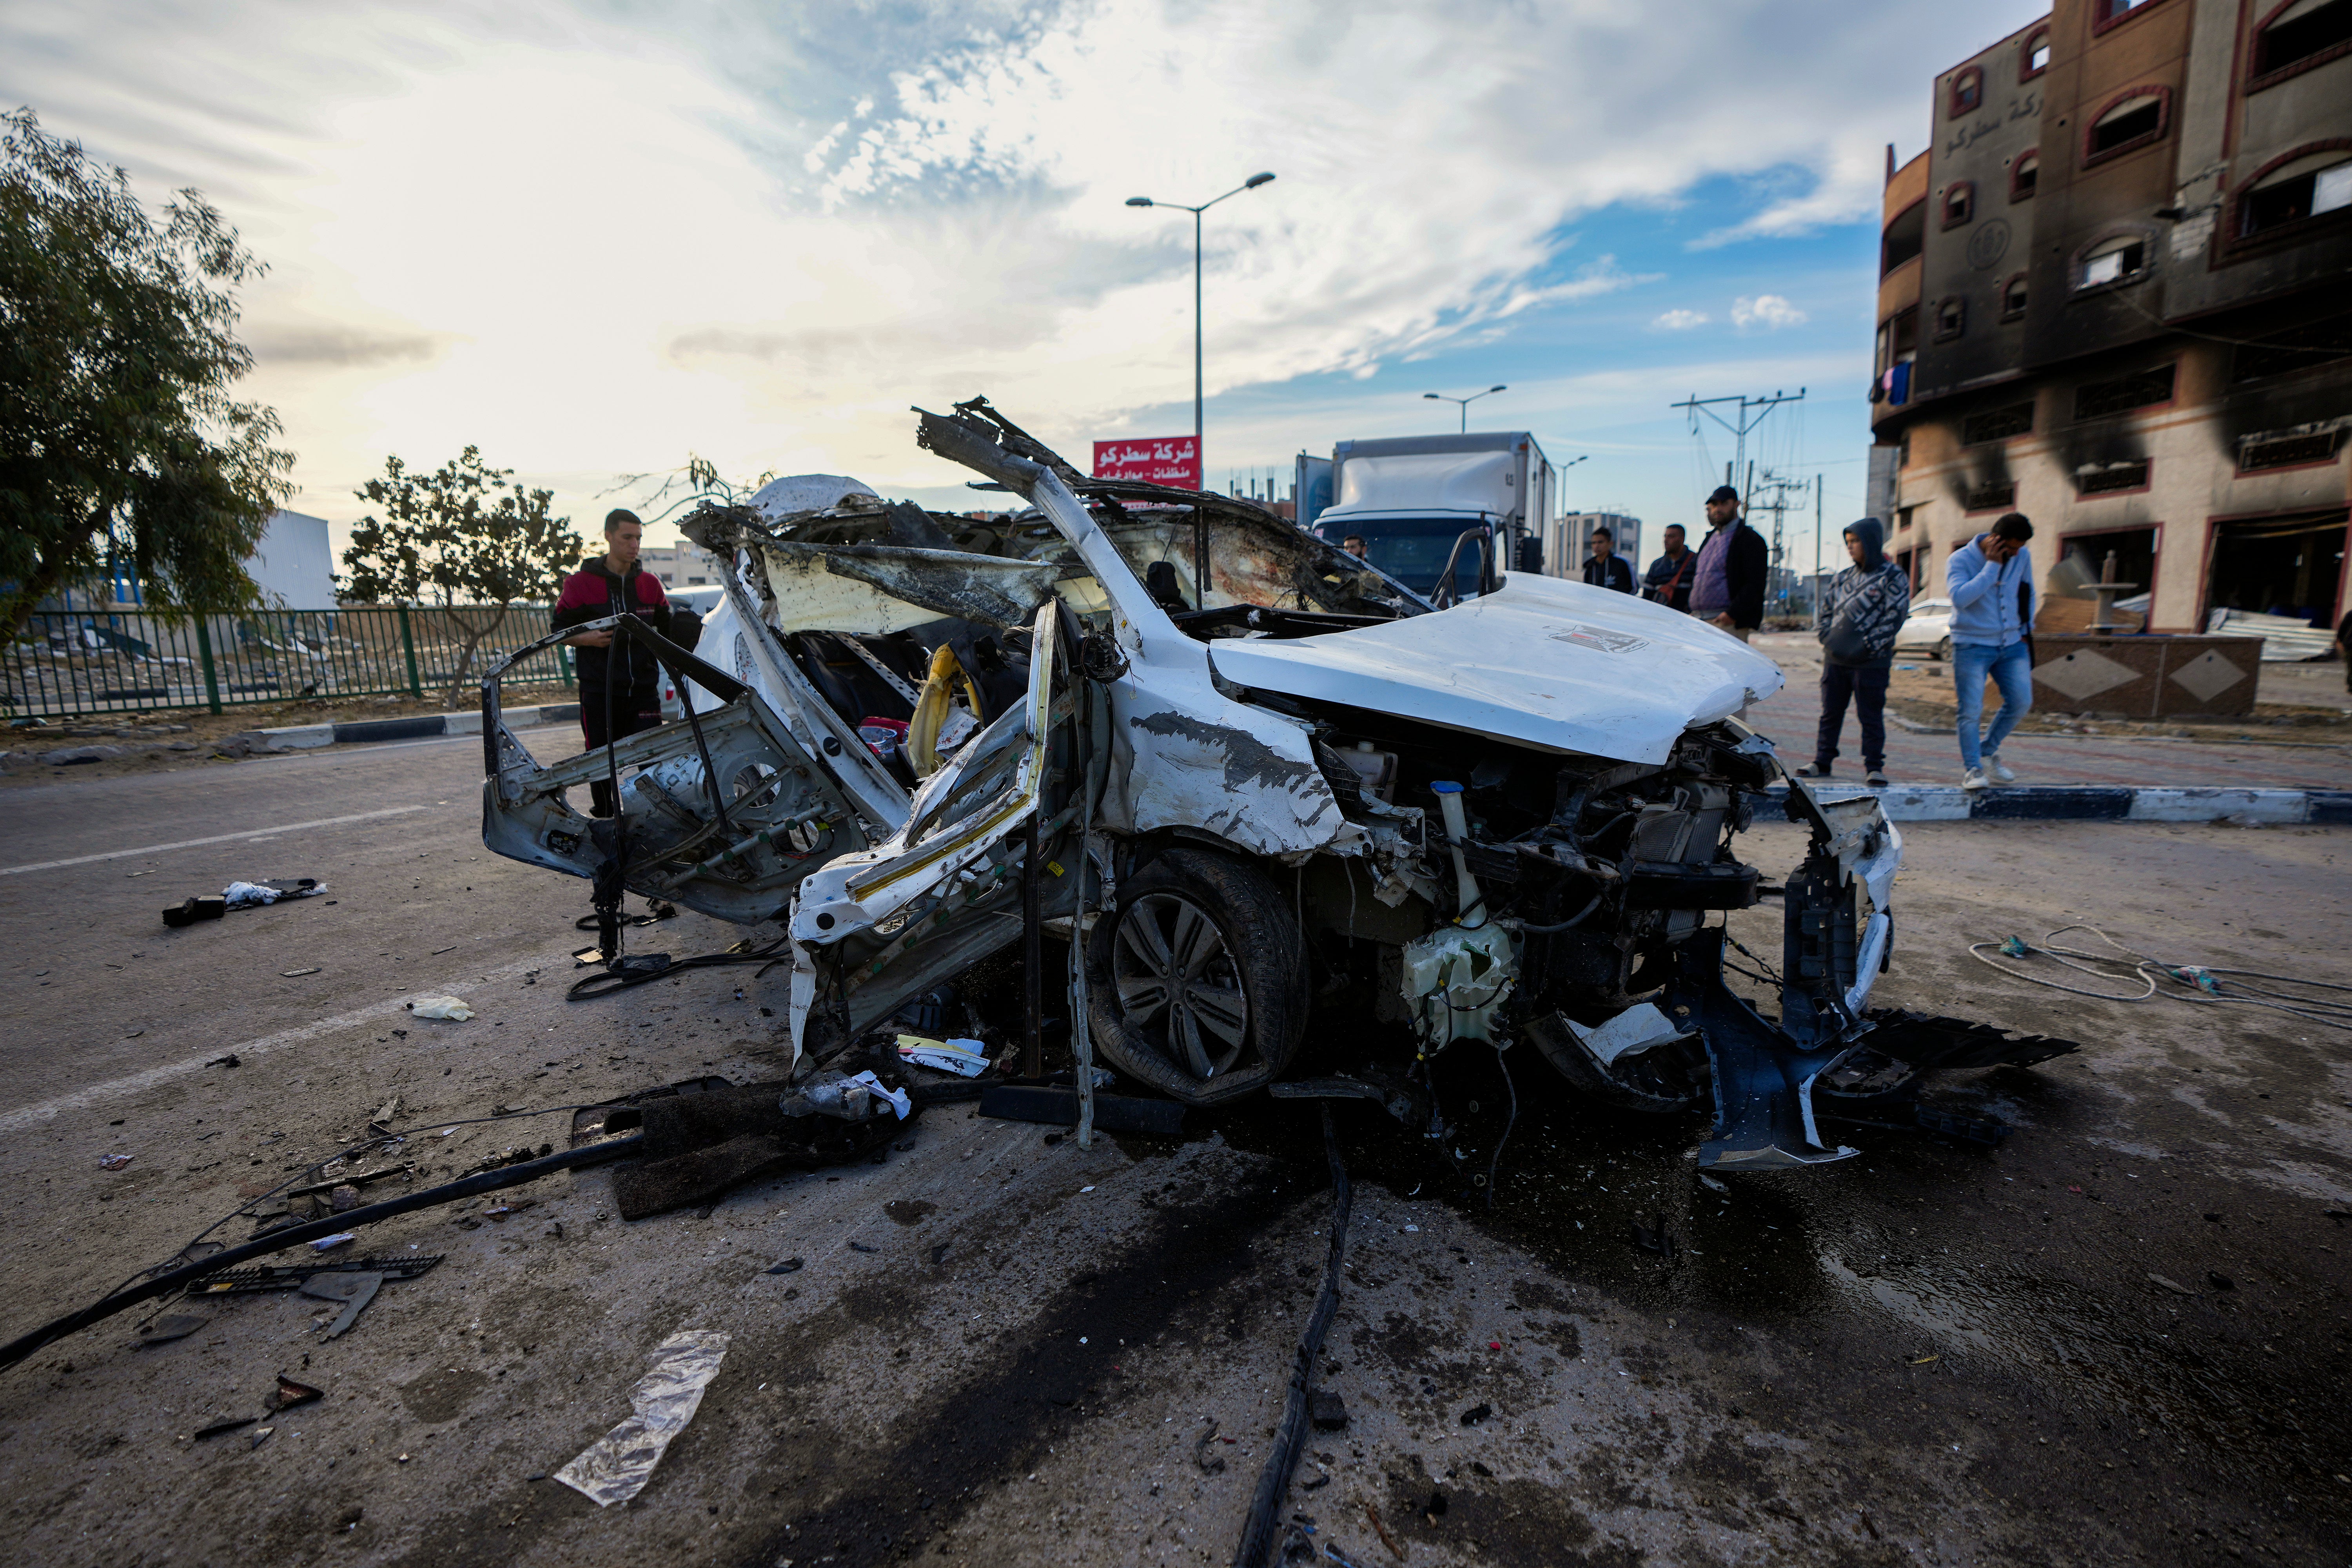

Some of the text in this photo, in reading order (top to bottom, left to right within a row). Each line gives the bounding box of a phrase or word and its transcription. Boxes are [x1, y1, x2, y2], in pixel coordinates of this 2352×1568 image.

[2009, 92, 2043, 121] ركة
[1097, 439, 1194, 468] شركة سطركو
[1152, 466, 1191, 479] منظفات
